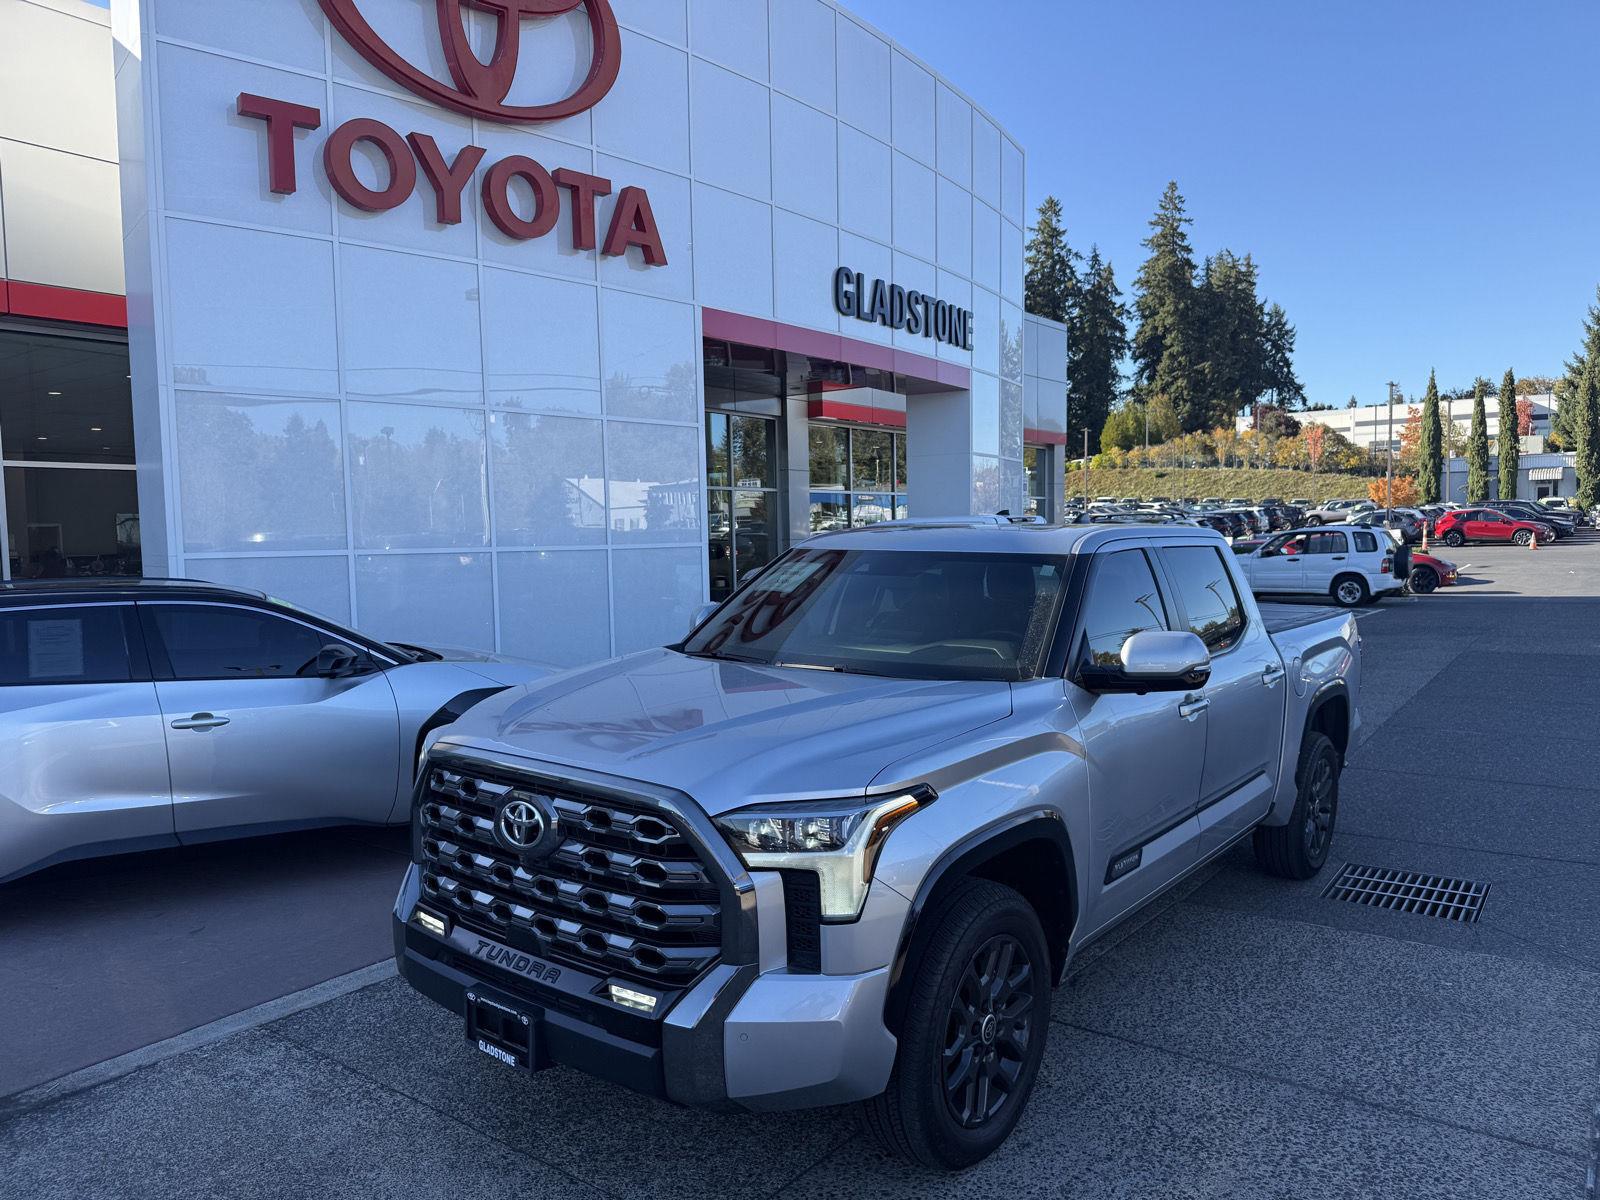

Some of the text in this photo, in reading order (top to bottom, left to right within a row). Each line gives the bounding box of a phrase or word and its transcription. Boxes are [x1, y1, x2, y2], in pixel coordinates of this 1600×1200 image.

[236, 92, 668, 266] TOYOTA
[834, 266, 974, 351] GLADSTONE
[475, 940, 562, 984] TUNDRA
[478, 1039, 516, 1067] GLADSTONE
